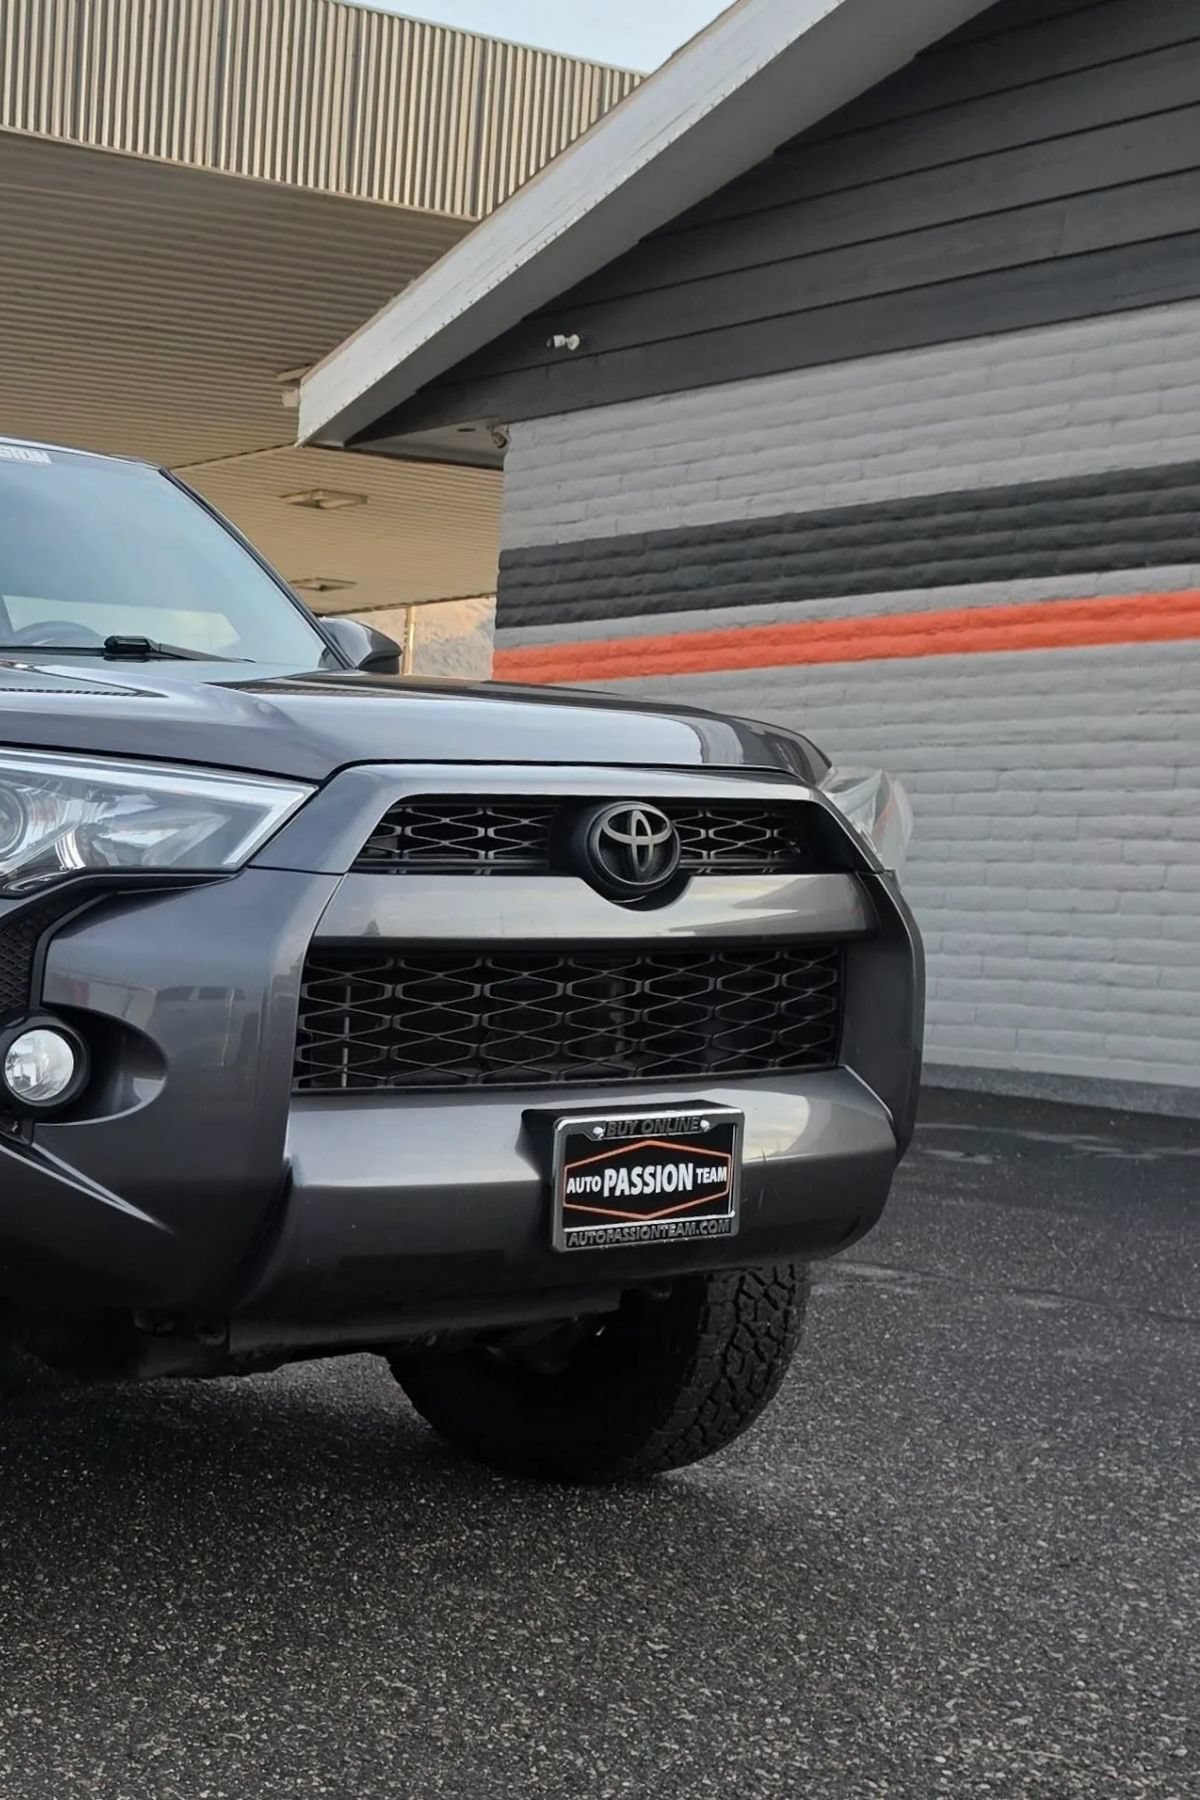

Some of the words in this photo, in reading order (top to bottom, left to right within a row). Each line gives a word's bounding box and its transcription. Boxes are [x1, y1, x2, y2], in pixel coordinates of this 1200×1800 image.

[606, 1121, 636, 1137] BUY
[641, 1117, 700, 1134] ONLINE
[566, 1175, 602, 1194] AUTO
[604, 1163, 693, 1197] PASSION
[697, 1167, 727, 1184] TEAM
[569, 1220, 730, 1246] AUTOPASSIONTEAM.COM
